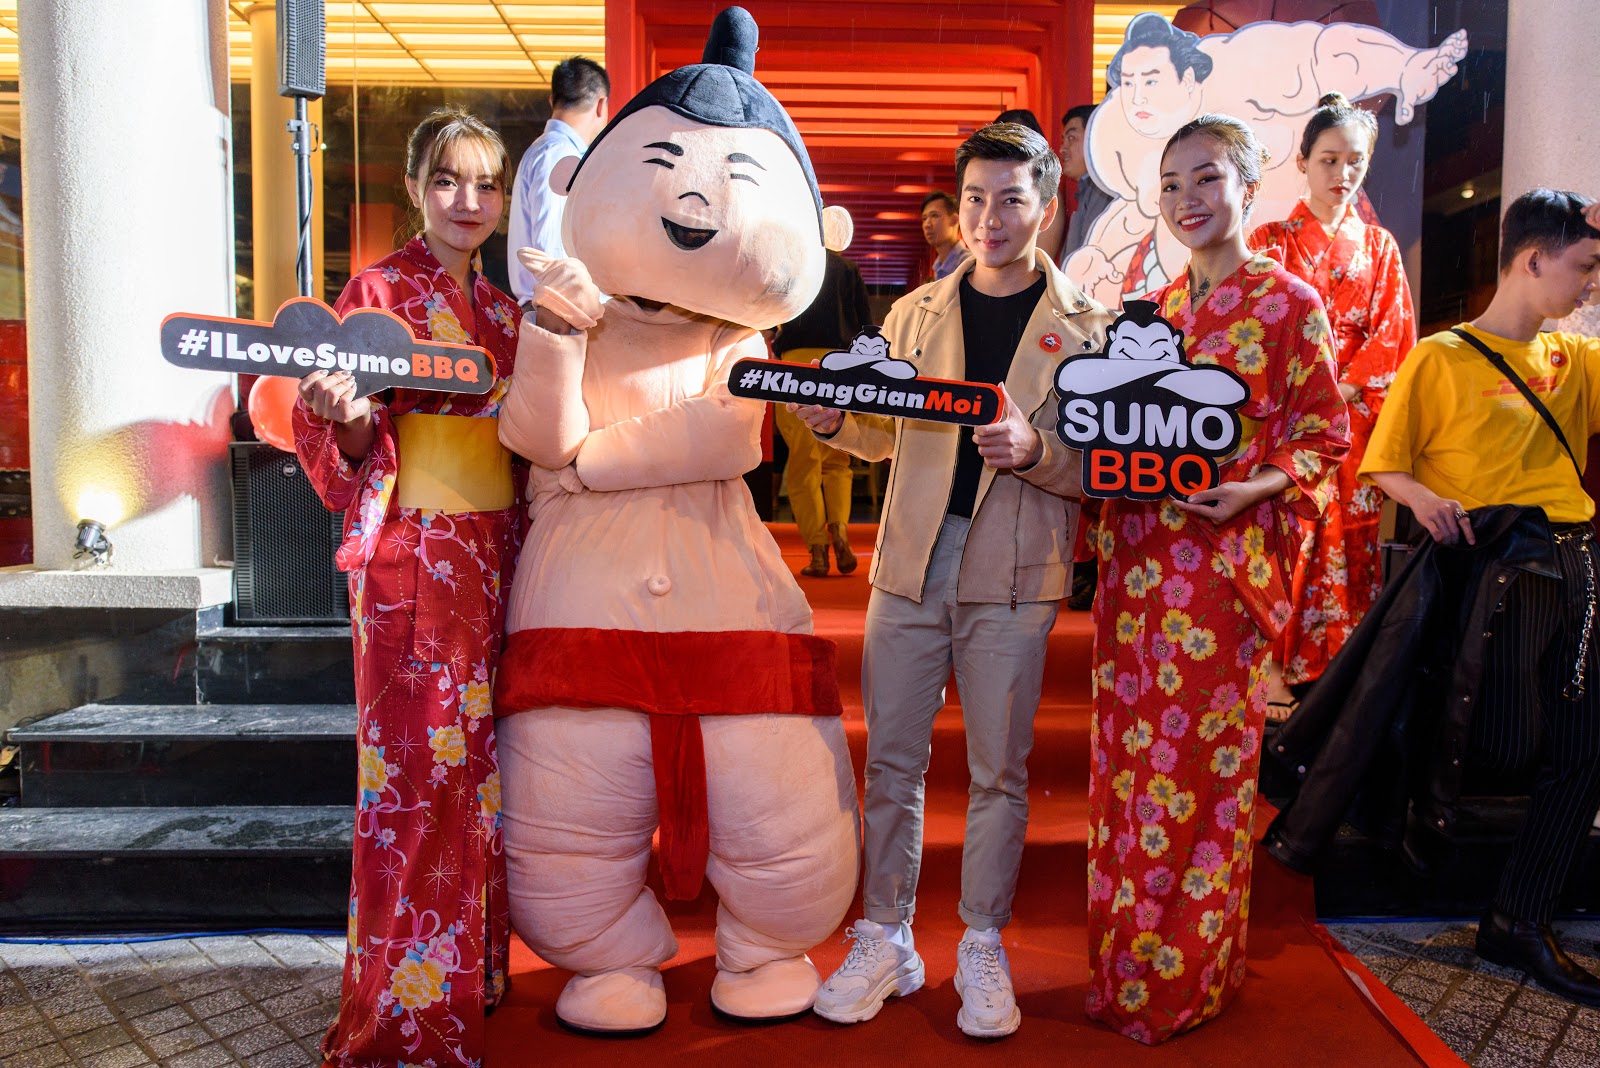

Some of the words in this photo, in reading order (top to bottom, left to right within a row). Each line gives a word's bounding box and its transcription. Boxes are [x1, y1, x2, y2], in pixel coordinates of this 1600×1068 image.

[178, 329, 479, 383] #ILoveSumoBBQ
[740, 369, 982, 416] #KhongGianMoi
[1064, 398, 1235, 450] SUMO
[1090, 449, 1212, 496] BBQ
